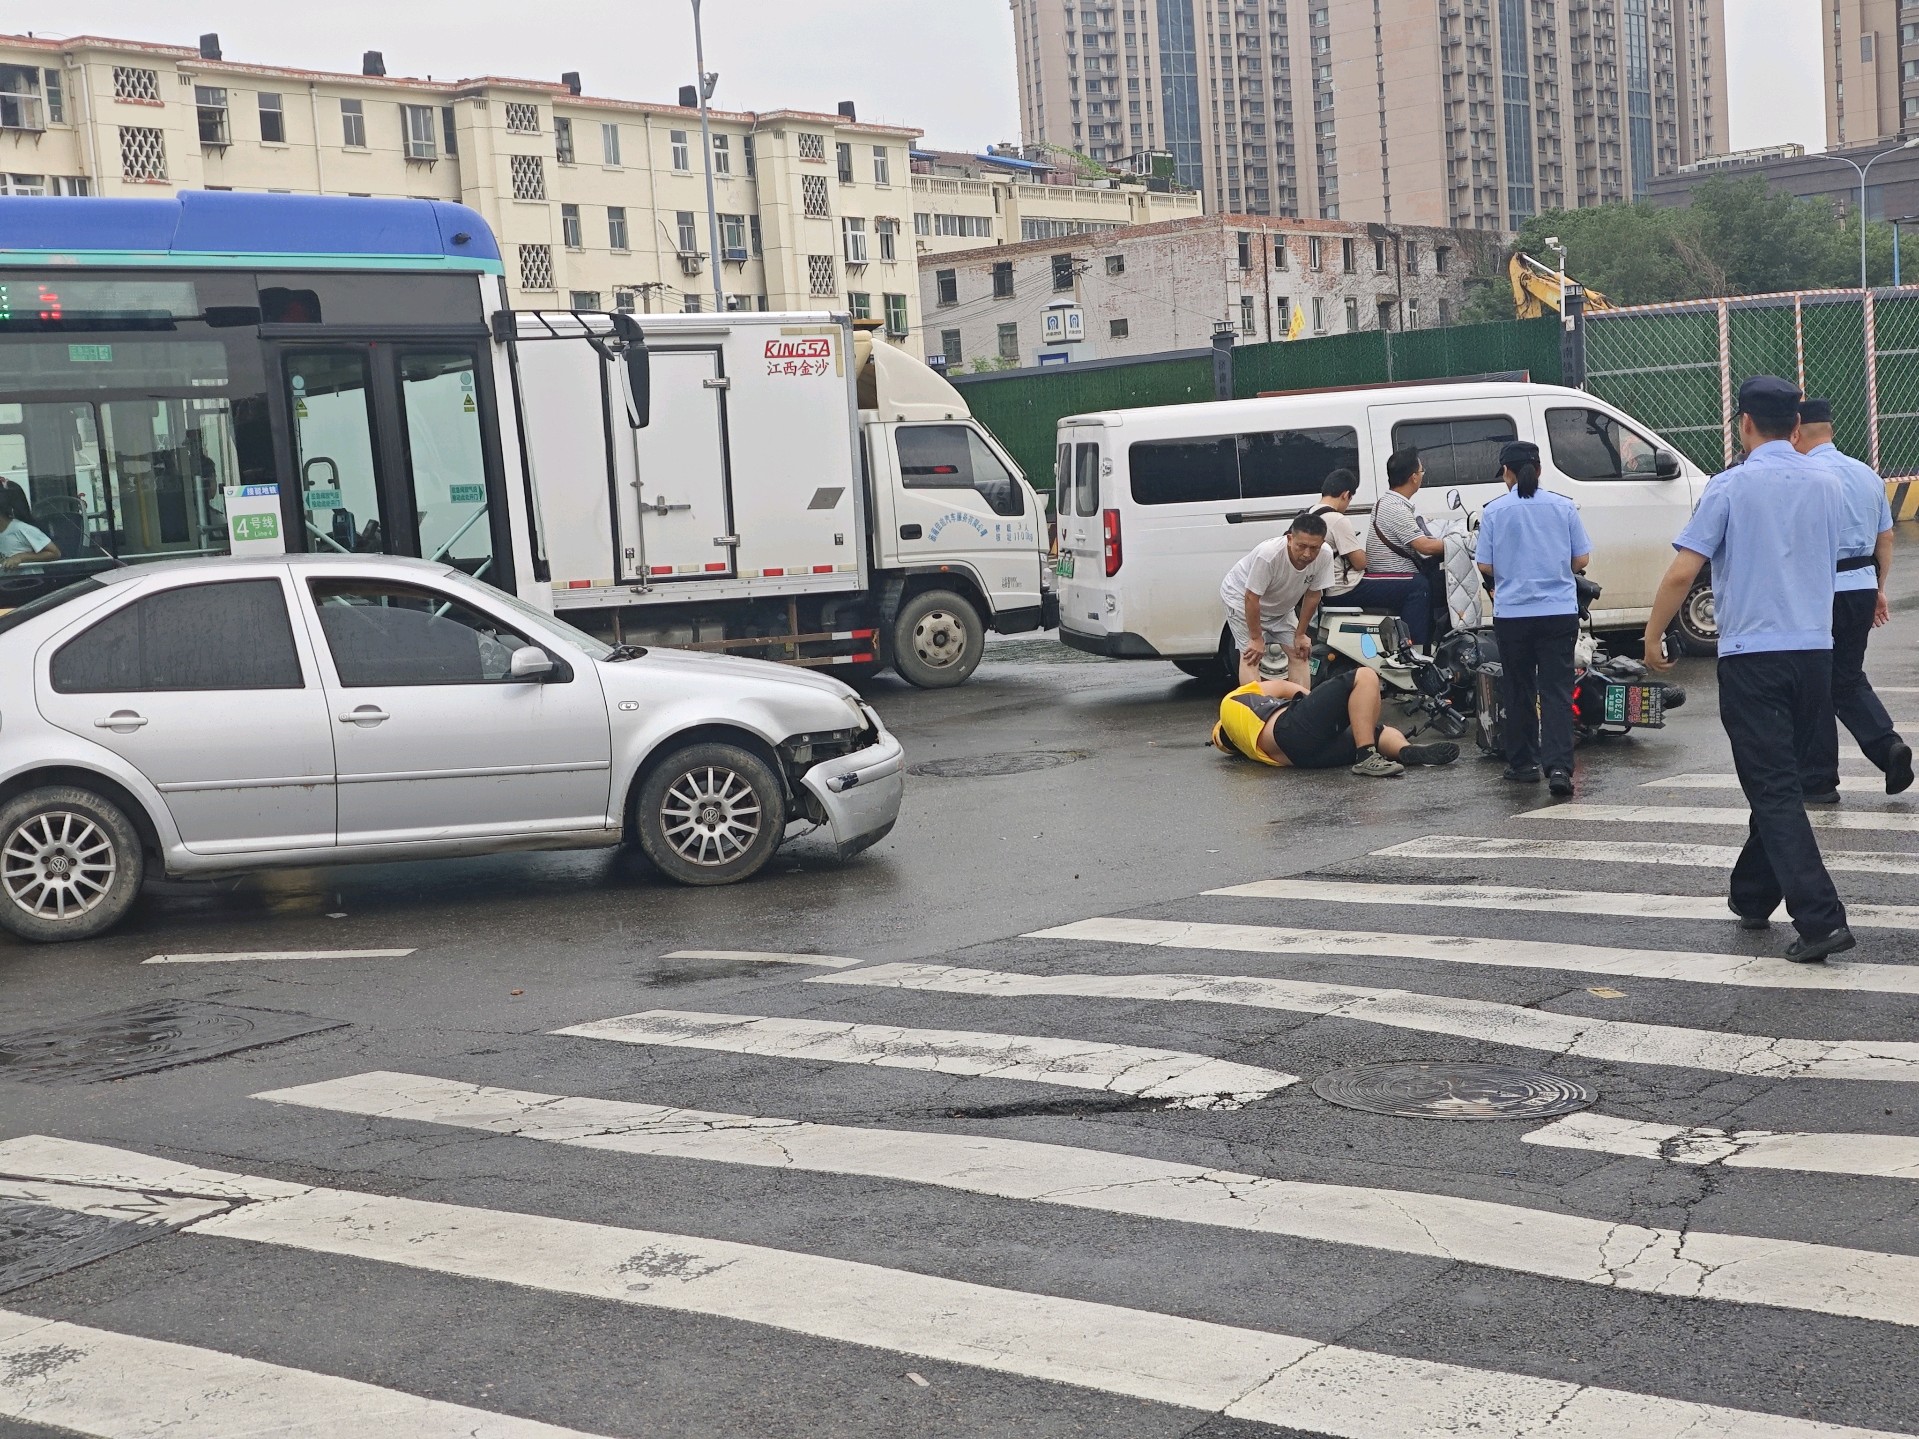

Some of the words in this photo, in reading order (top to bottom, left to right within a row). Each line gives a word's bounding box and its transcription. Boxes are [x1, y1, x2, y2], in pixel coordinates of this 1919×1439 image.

[765, 339, 830, 358] KINGSA
[767, 359, 829, 376] 江西金沙
[246, 486, 277, 496] 接驳地铁
[1614, 688, 1624, 719] 573021
